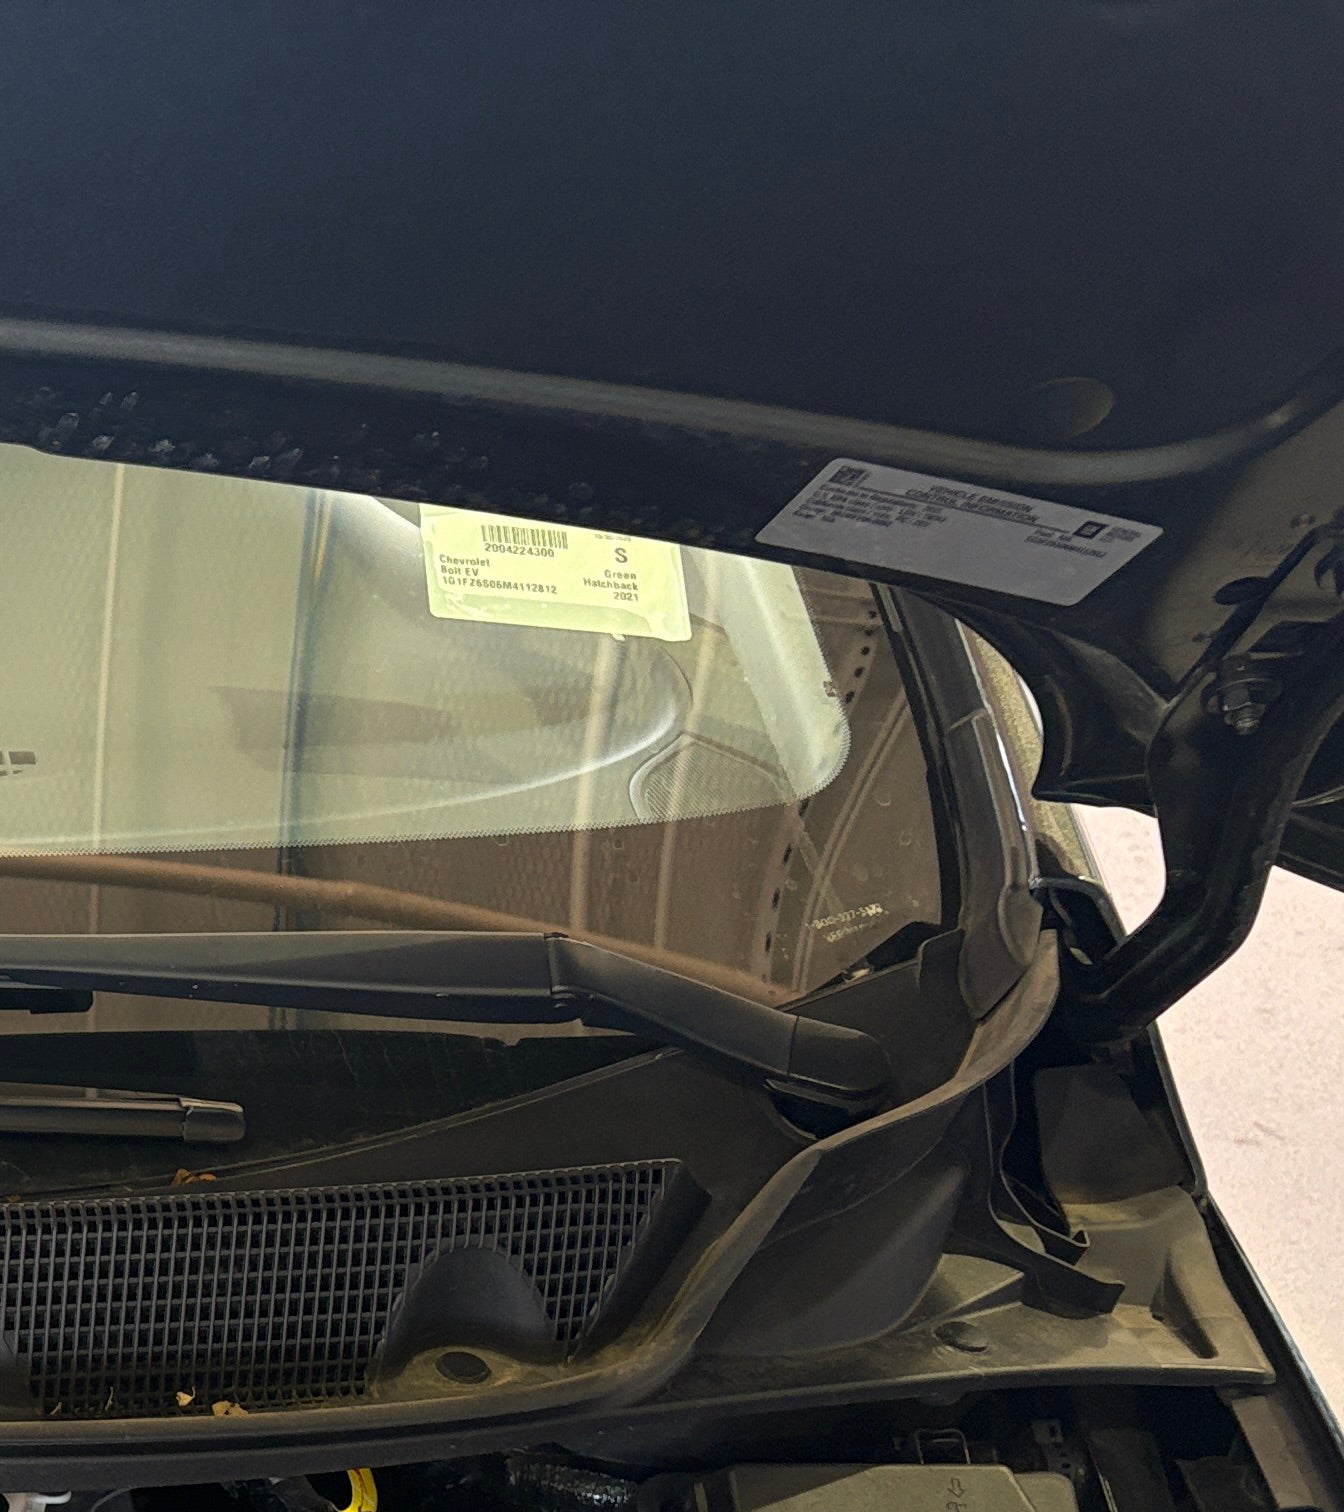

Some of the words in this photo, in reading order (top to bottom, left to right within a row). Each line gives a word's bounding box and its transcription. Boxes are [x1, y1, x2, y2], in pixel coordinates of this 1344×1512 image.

[484, 542, 555, 558] 2004224300
[614, 547, 628, 563] S
[439, 554, 491, 567] Chevrolet
[441, 565, 461, 575] Bolt
[465, 567, 479, 576] EV
[604, 569, 637, 580] Green
[583, 577, 639, 591] Hatchback
[613, 591, 639, 601] 2021
